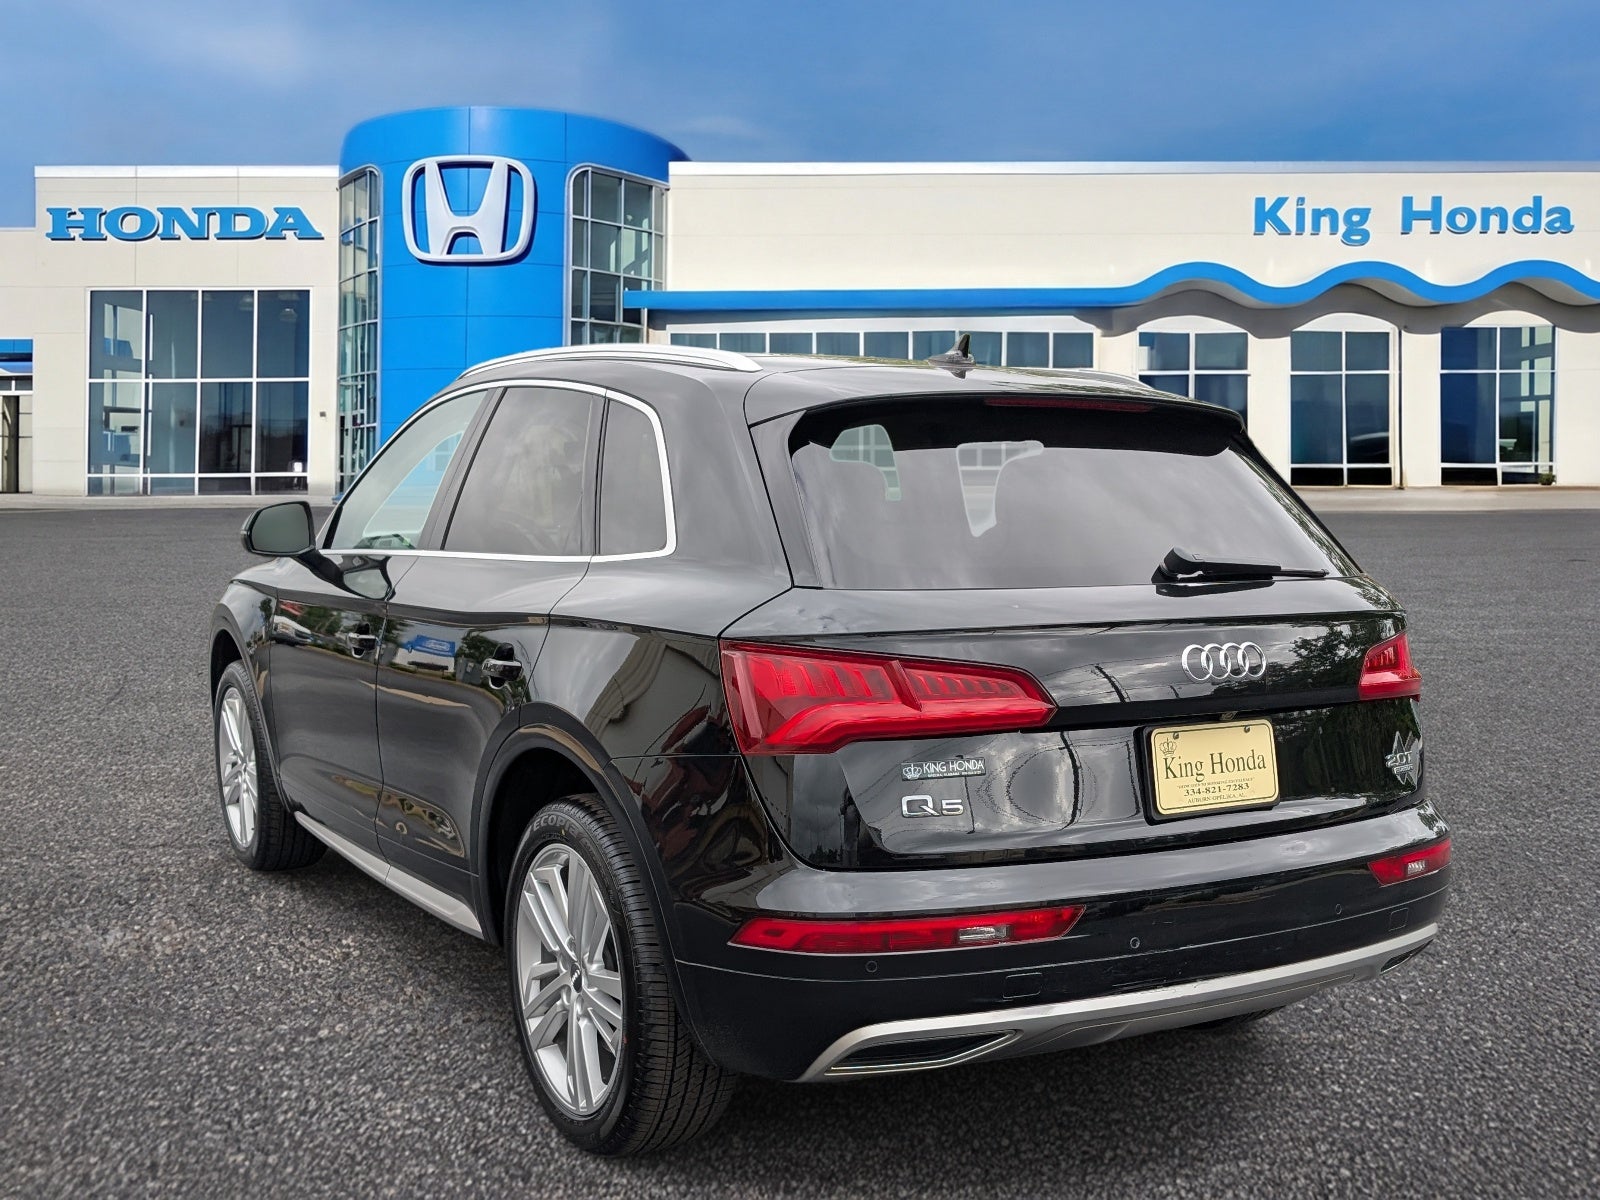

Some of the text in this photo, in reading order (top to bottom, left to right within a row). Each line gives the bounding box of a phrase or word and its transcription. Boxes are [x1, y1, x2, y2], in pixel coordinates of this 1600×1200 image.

[45, 206, 324, 241] HONDA
[1254, 195, 1575, 246] King Honda
[922, 762, 947, 774] KING
[949, 759, 985, 771] HONDA
[1163, 749, 1267, 782] King Honda
[1184, 783, 1250, 796] 334-821-7283
[901, 794, 964, 819] Q5
[533, 814, 580, 839] ECOPIA
